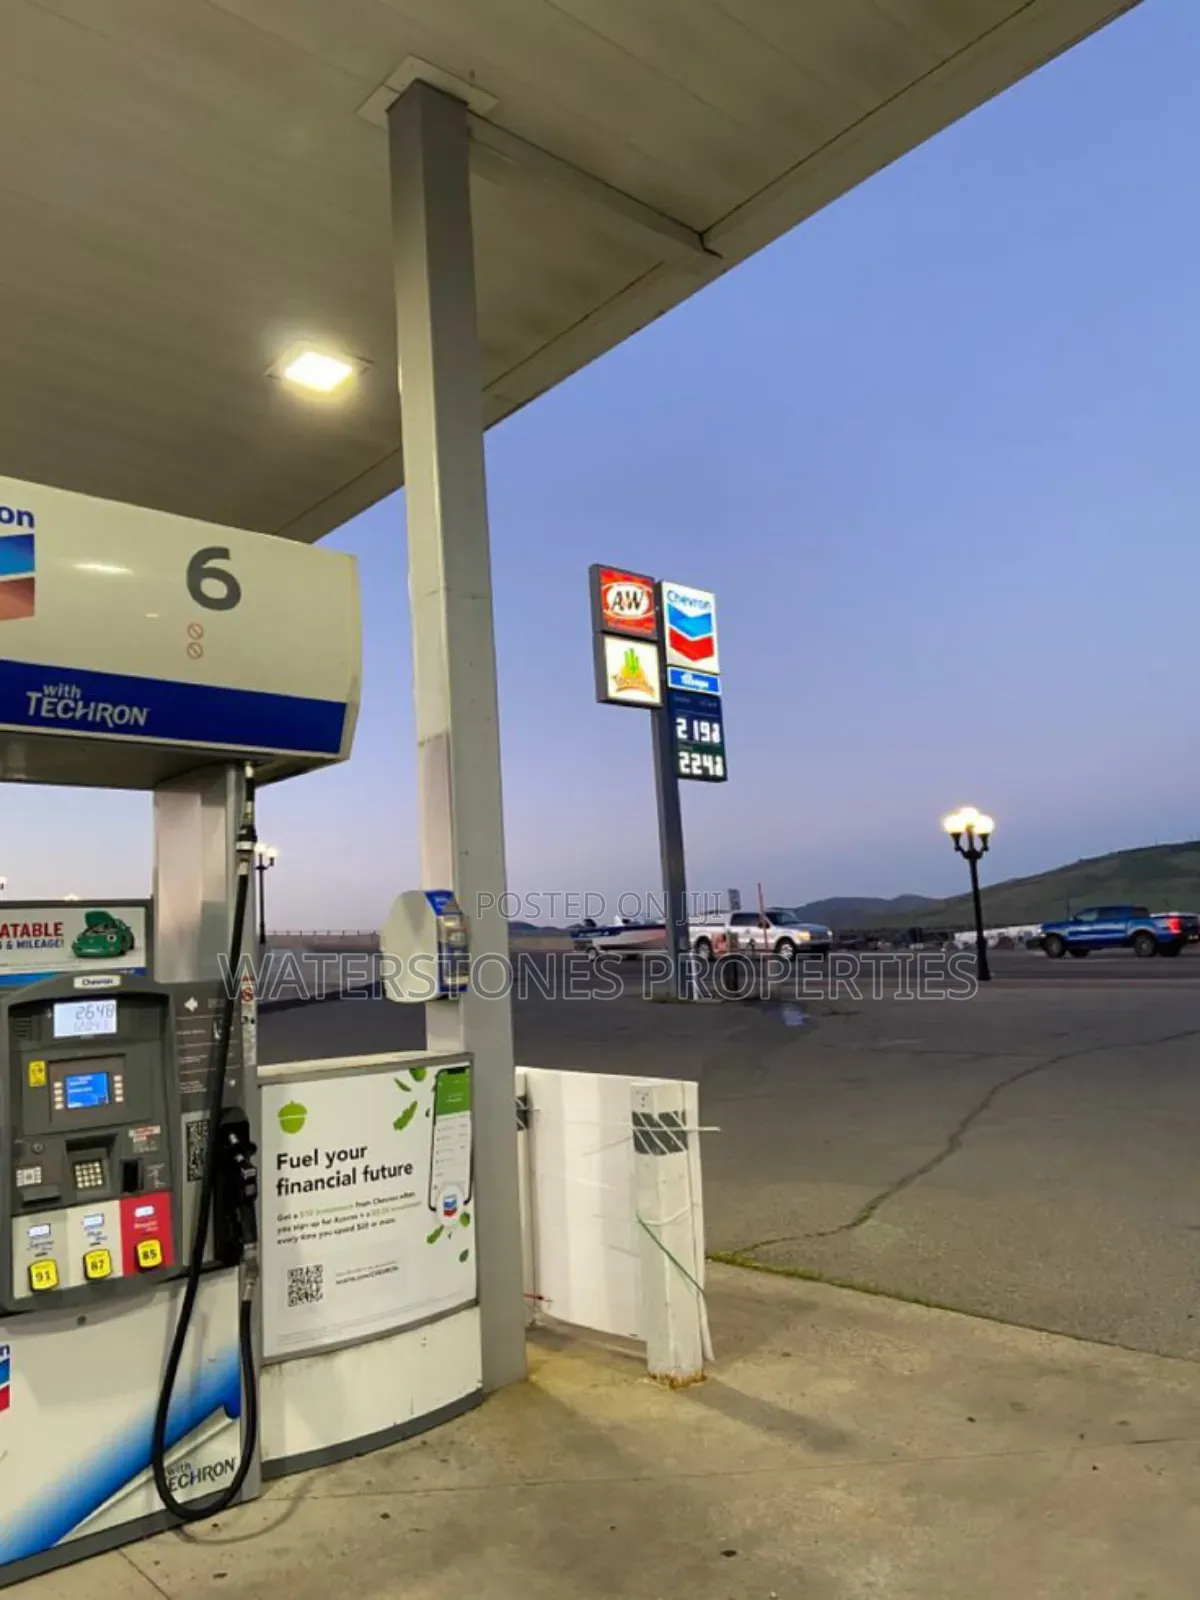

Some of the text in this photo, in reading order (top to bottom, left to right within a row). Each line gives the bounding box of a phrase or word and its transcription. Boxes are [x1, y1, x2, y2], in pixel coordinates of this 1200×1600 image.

[186, 546, 242, 611] 6
[43, 682, 81, 700] with
[26, 690, 149, 728] TECHRON
[0, 921, 64, 938] ATABLE
[276, 1146, 368, 1170] Fuel your
[275, 1163, 414, 1197] financial future
[35, 1271, 51, 1283] 91
[168, 1457, 236, 1492] ECHRON
